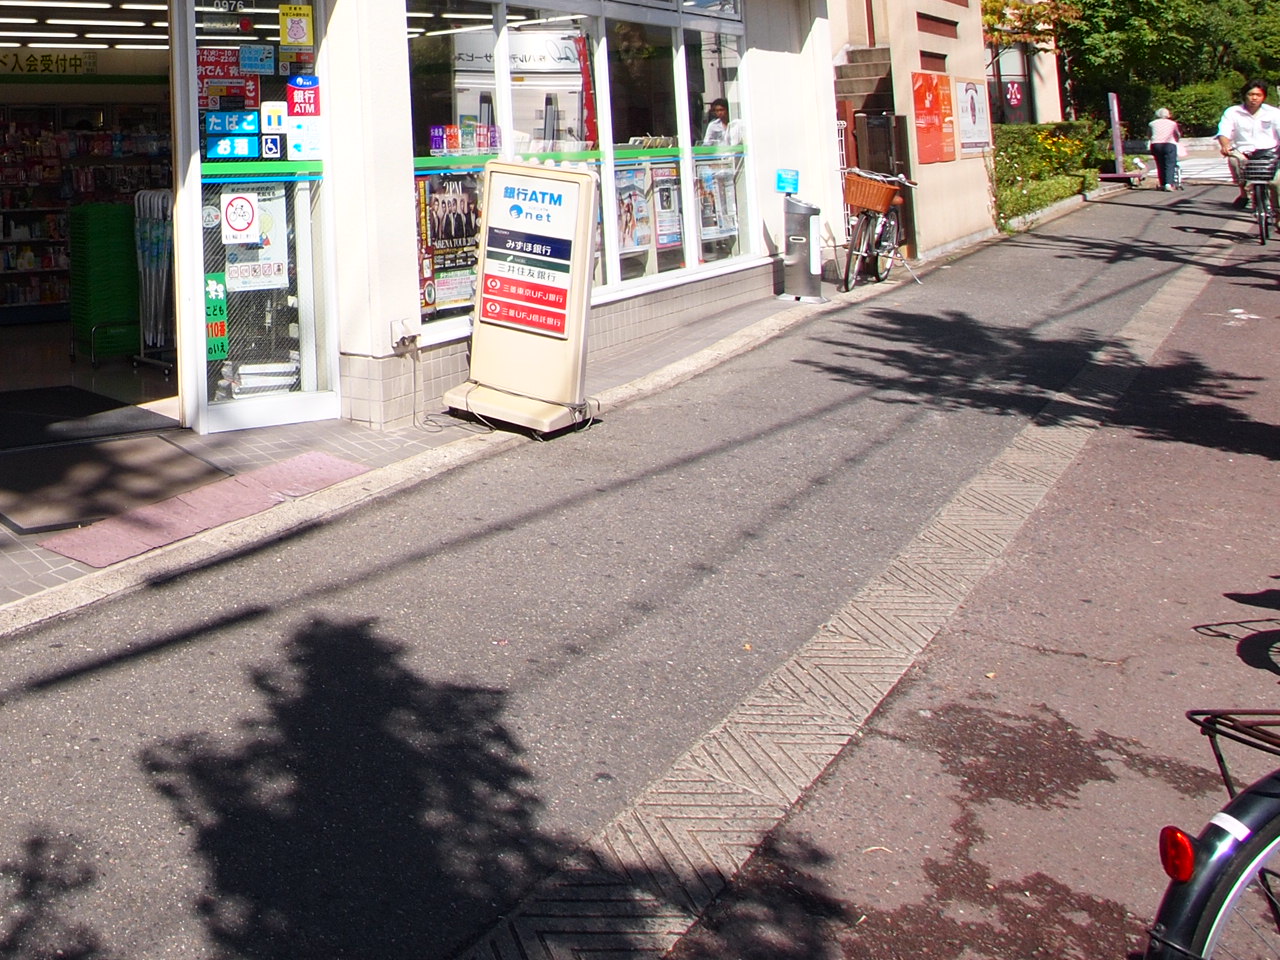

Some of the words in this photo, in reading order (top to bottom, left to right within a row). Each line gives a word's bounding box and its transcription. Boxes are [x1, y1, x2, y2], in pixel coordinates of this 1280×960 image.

[214, 0, 245, 11] 0976
[293, 90, 315, 103] 銀行
[293, 103, 315, 113] ATM
[209, 115, 256, 131] たばこ
[217, 138, 250, 155] お酒
[443, 181, 463, 195] 2PM
[503, 186, 563, 207] 銀行ATM
[505, 240, 552, 256] みずほ銀行
[497, 263, 558, 282] 三井住友銀行
[502, 284, 564, 303] 三菱東京UFJ銀行
[206, 305, 225, 317] こども
[500, 308, 562, 328] 三菱UFJ信託銀行
[206, 321, 226, 338] 110番
[207, 342, 227, 355] のいえ
